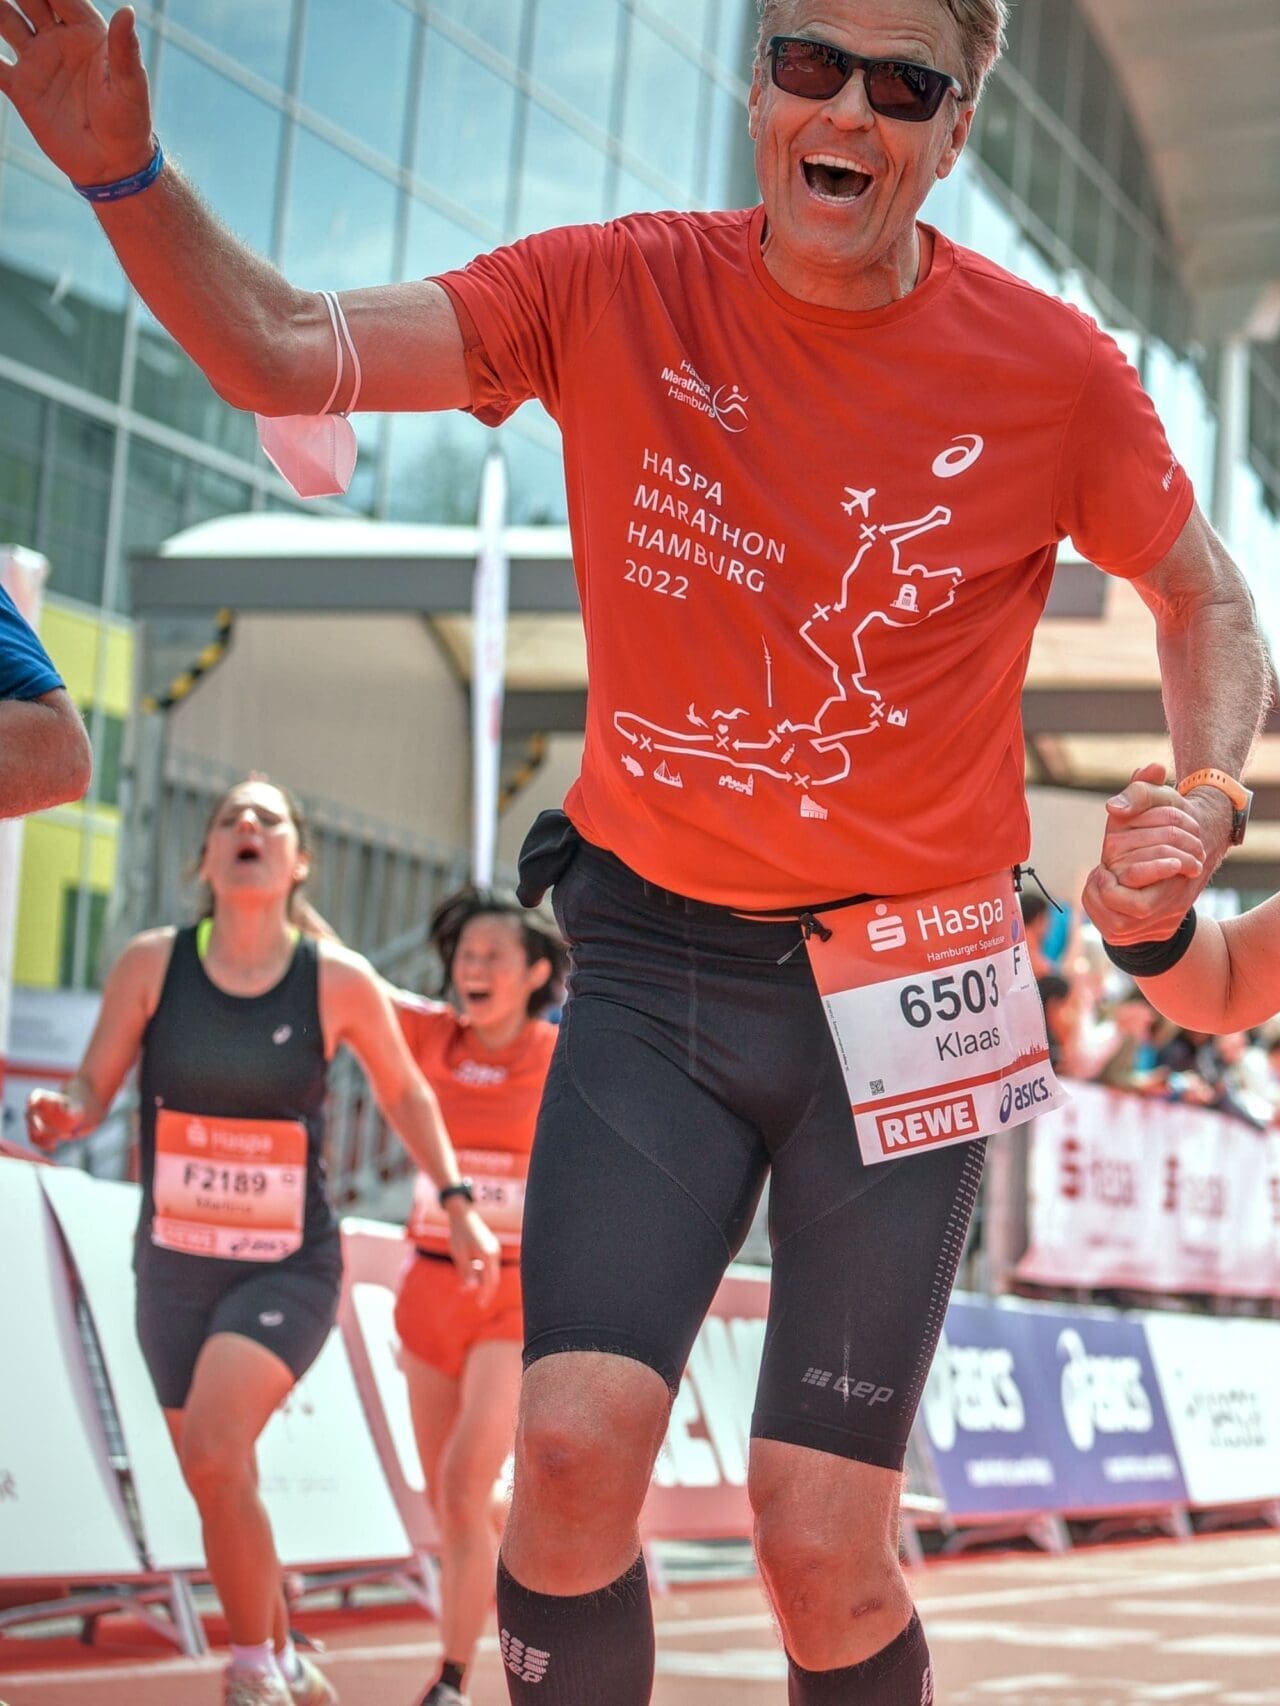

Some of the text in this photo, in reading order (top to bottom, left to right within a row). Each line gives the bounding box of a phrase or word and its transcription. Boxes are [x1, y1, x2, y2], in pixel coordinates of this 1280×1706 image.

[667, 386, 716, 418] Hamburg
[642, 448, 722, 506] HASPA
[633, 484, 786, 564] MARATHON
[627, 521, 765, 593] HAMBURG
[623, 559, 689, 600] 2022
[916, 898, 1004, 941] Haspa
[926, 943, 978, 963] Hamburger
[1013, 945, 1021, 976] F
[900, 963, 999, 1028] 6503
[935, 1026, 1001, 1061] Klaas
[882, 1101, 974, 1148] REWE
[184, 1162, 267, 1195] F2189
[833, 1376, 895, 1406] cep
